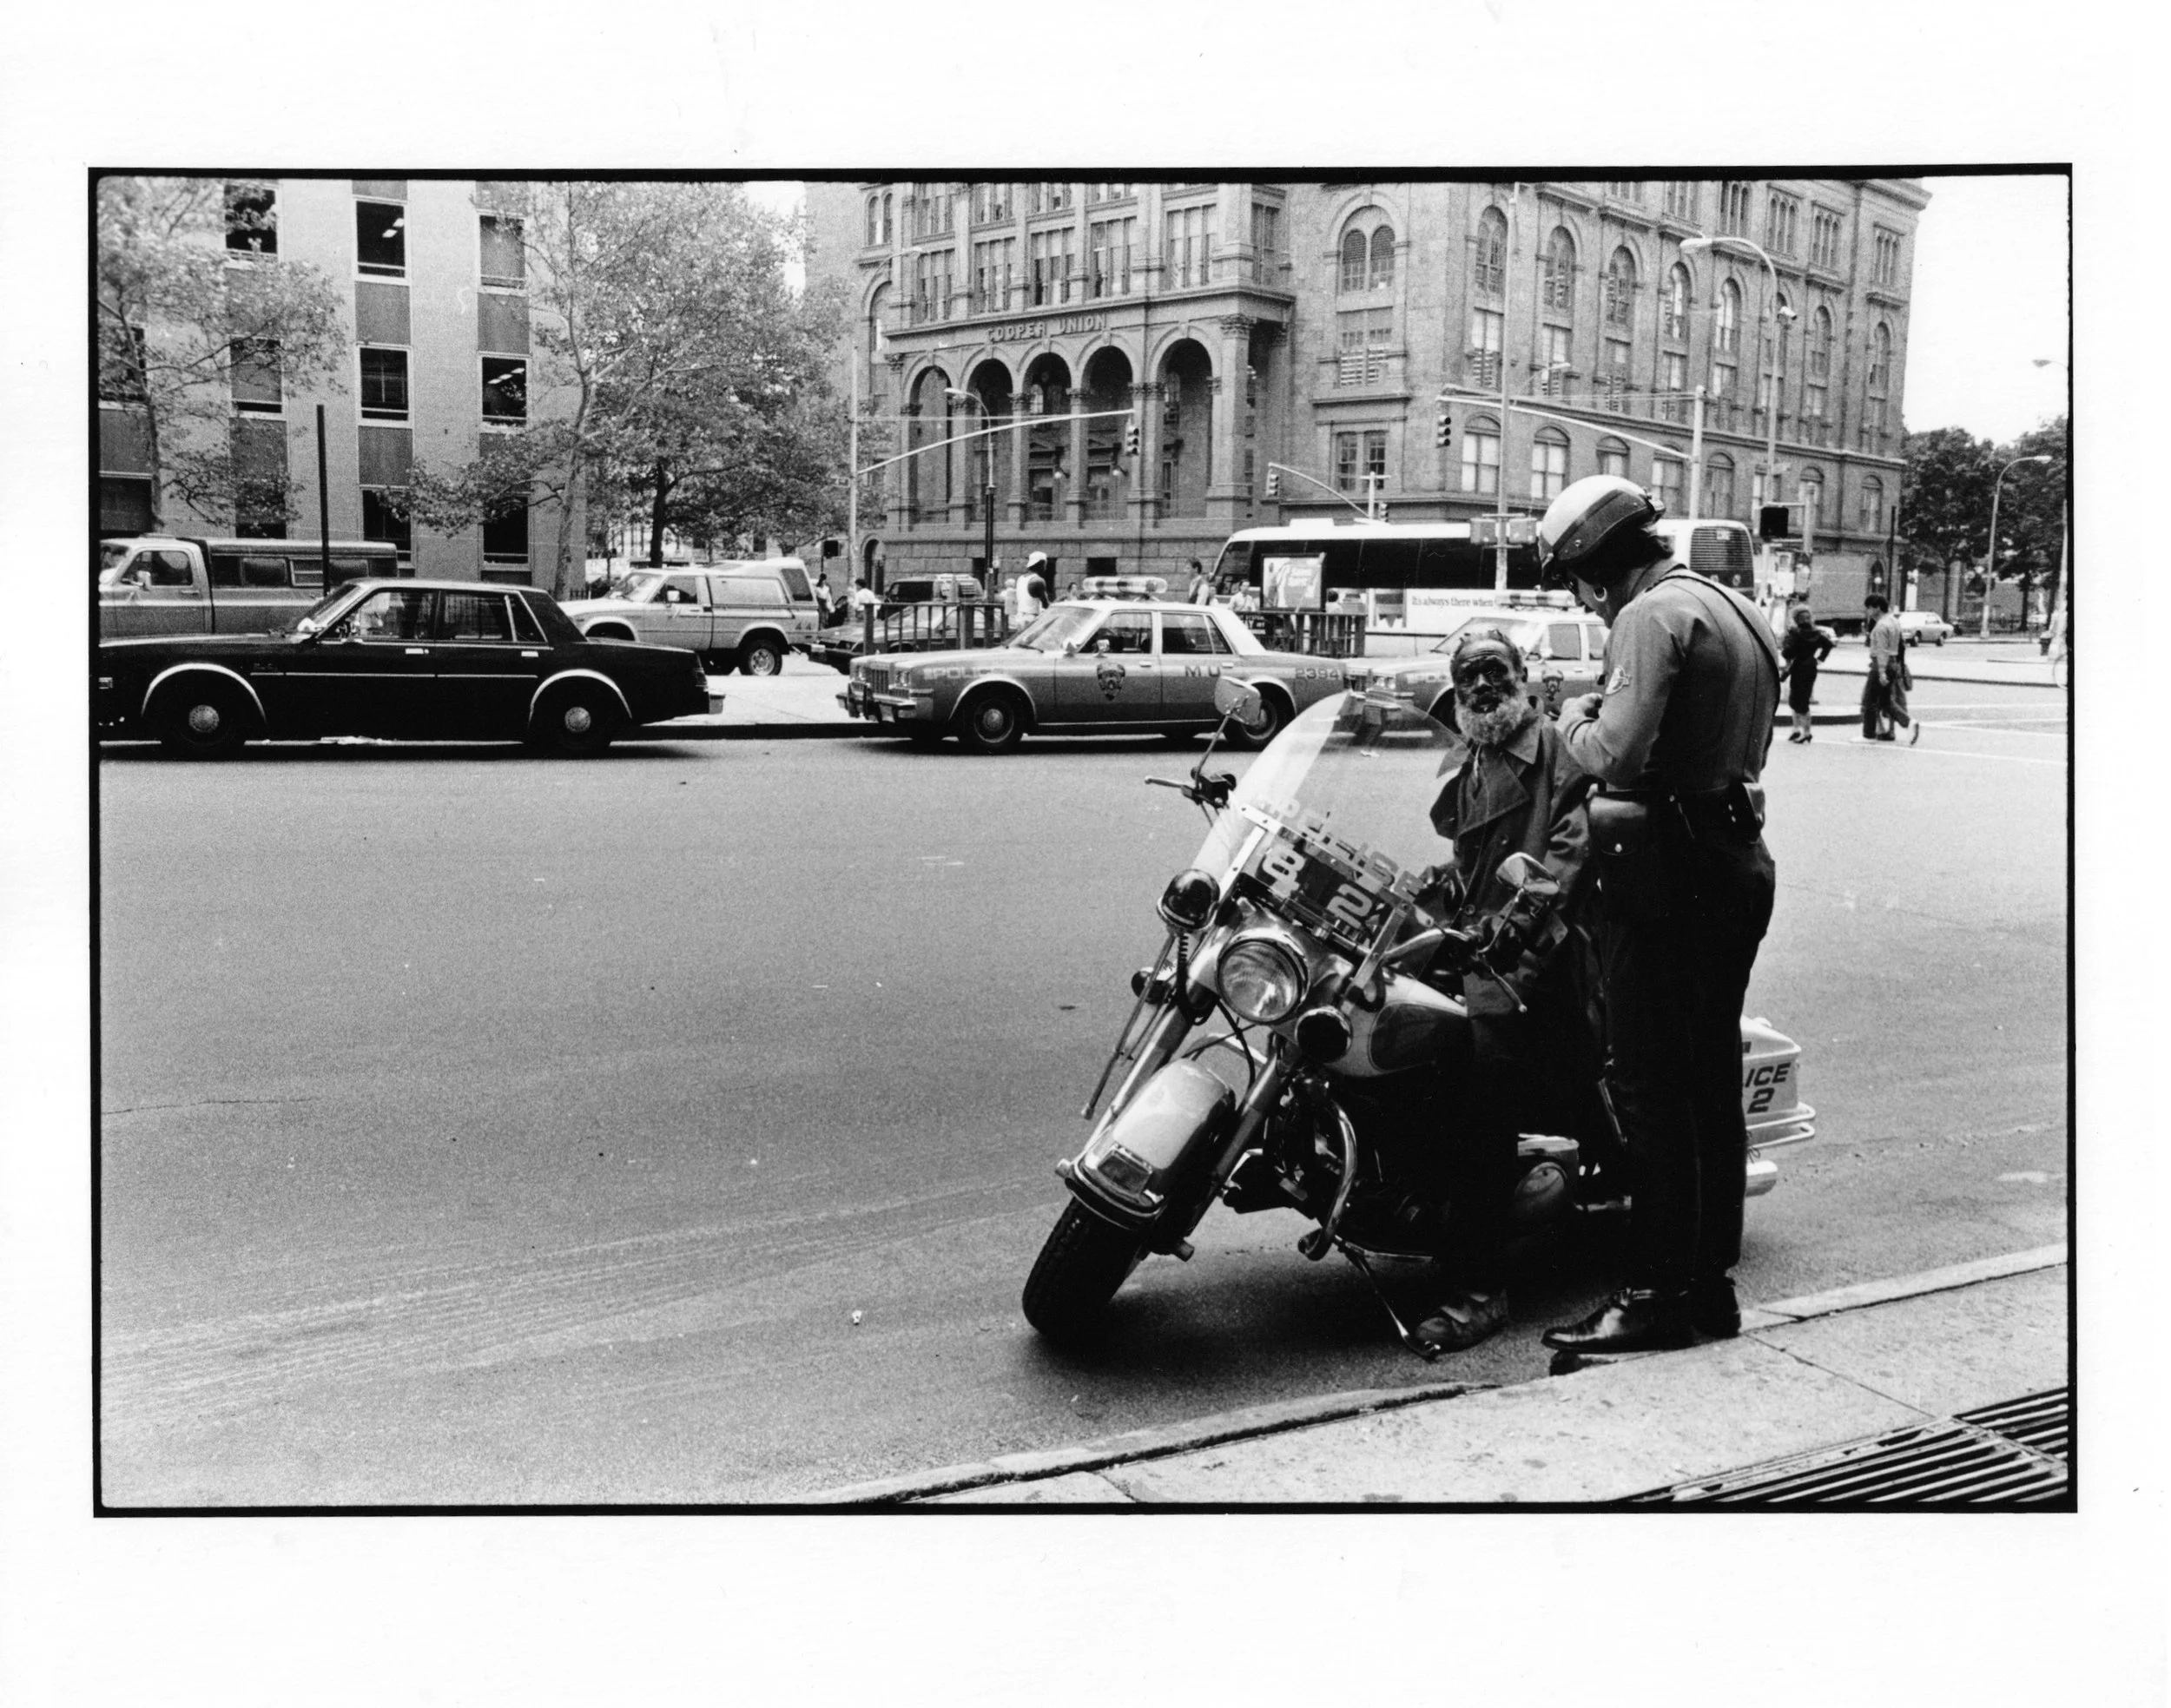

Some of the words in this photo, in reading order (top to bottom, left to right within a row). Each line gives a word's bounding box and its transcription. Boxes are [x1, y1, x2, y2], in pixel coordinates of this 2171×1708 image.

[988, 321, 1047, 342] COOPER
[1058, 313, 1107, 333] UNION
[1423, 596, 1449, 609] always
[1451, 597, 1470, 606] there
[1472, 597, 1494, 607] when
[1295, 668, 1340, 680] 2394
[1744, 1062, 1792, 1088] ICE
